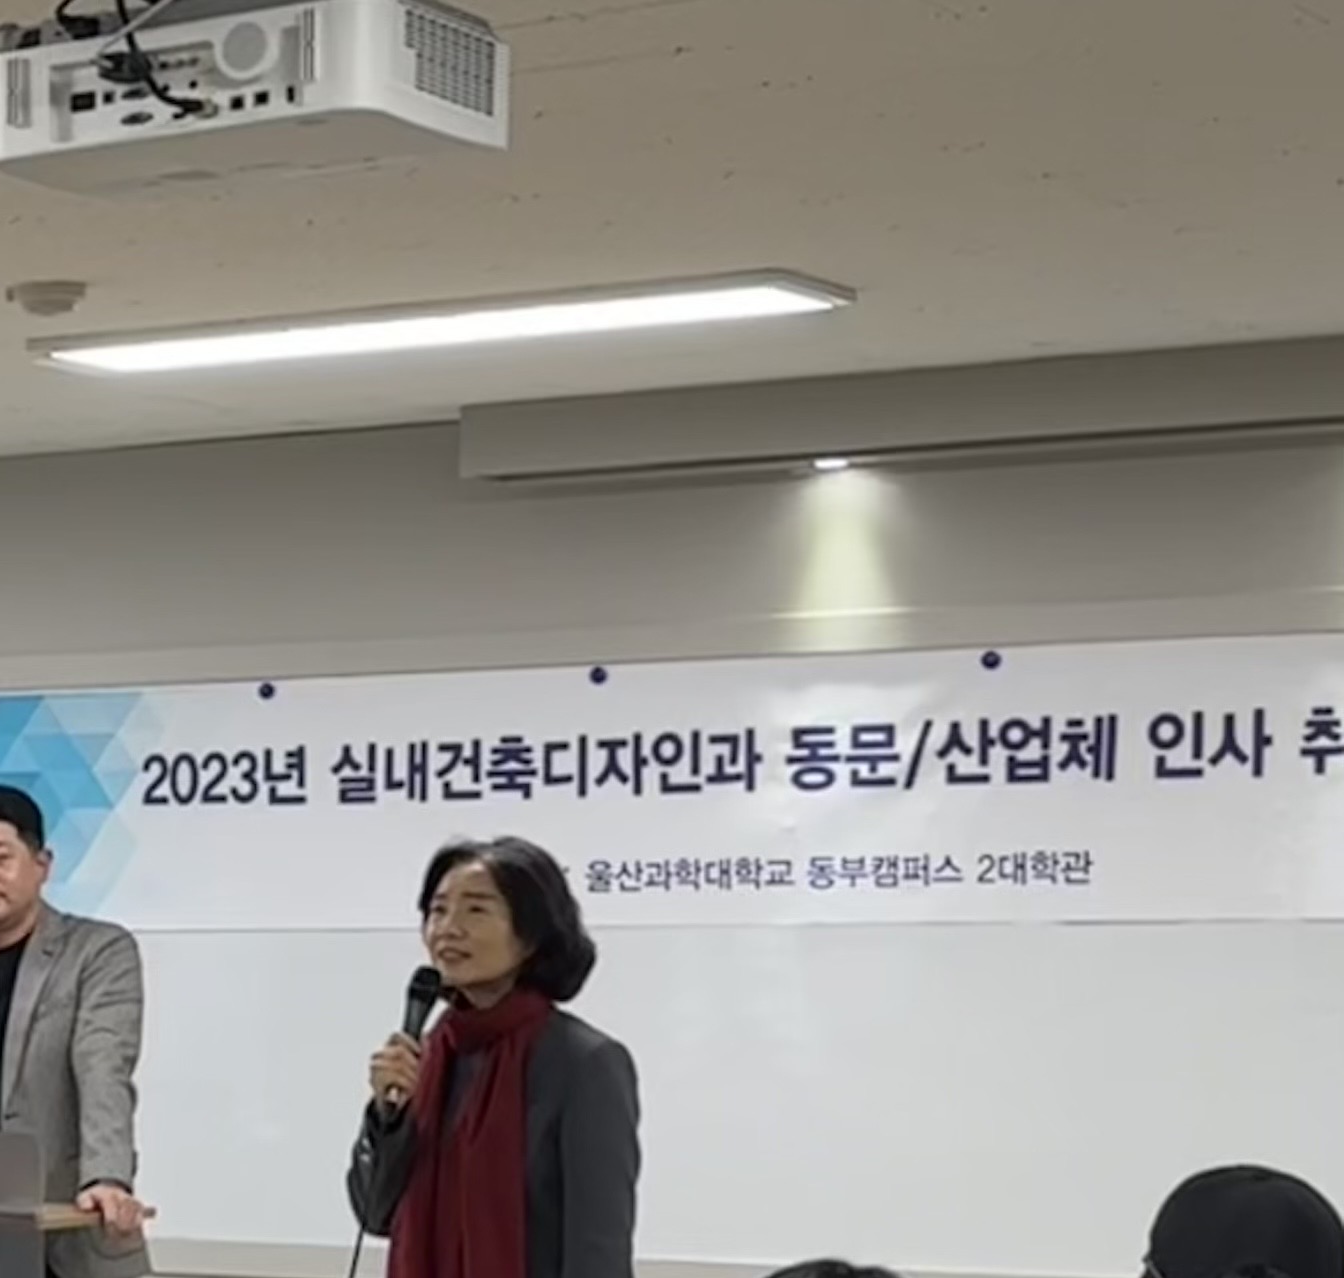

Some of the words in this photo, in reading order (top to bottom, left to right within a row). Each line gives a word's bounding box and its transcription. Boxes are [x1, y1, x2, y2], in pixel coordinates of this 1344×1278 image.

[142, 745, 307, 805] 2023년
[330, 728, 763, 804] 실내건축디자인과
[785, 713, 1119, 791] 동문/산업체
[1148, 708, 1273, 779] 인사
[585, 857, 795, 893] 울산과학대학교
[807, 853, 964, 890] 동부캠퍼스
[977, 850, 1094, 885] 2대학관
